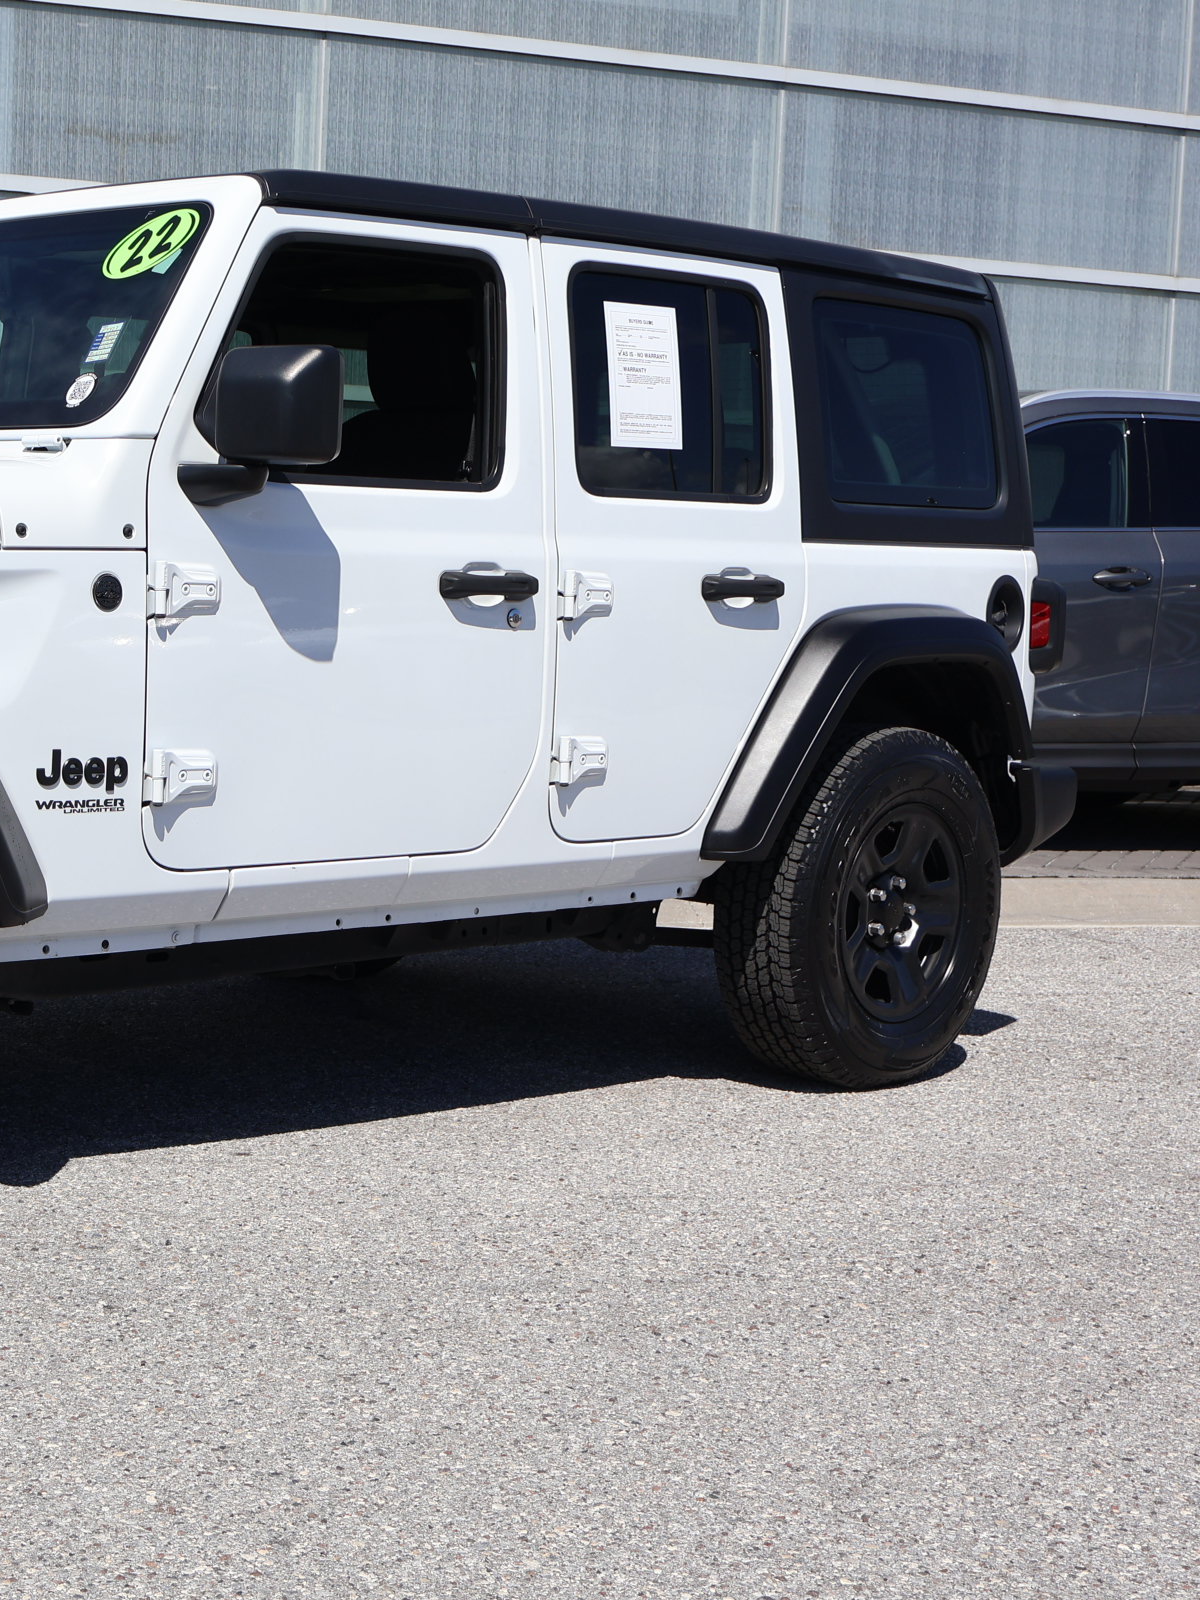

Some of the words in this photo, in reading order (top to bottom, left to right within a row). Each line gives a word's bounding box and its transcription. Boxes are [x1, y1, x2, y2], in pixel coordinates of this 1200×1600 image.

[120, 214, 182, 273] 22
[623, 366, 647, 374] WARRANTY
[36, 749, 128, 791] Jeep
[35, 798, 124, 810] WRANGLER
